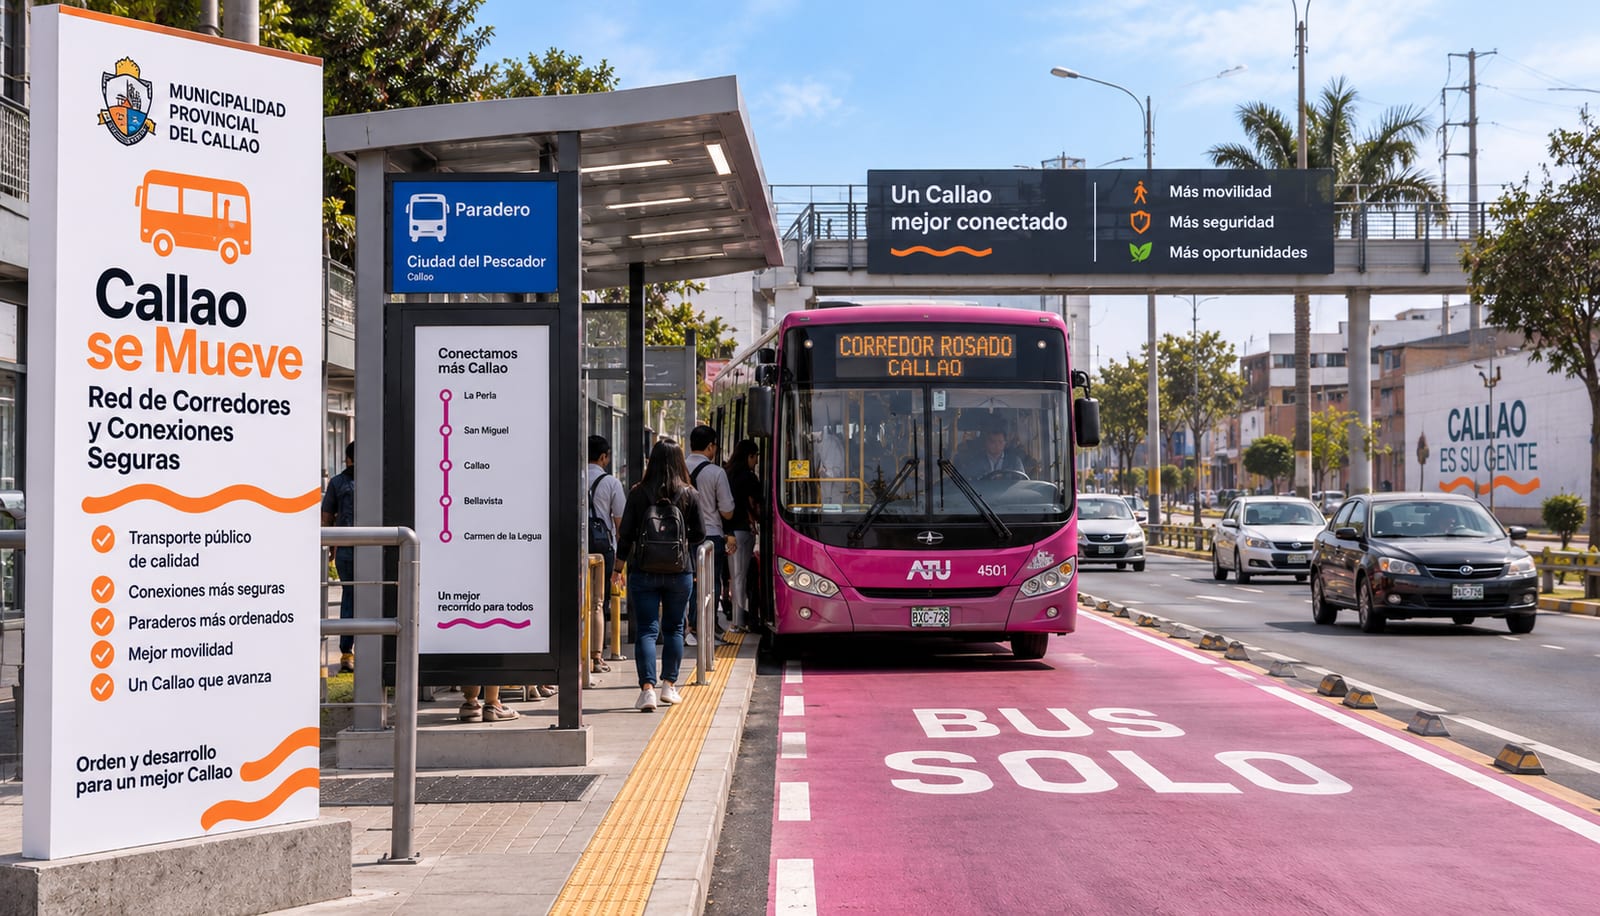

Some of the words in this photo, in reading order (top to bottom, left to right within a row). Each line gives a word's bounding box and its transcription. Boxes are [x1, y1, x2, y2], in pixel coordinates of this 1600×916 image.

[169, 83, 286, 117] MUNICIPALIDAD
[169, 104, 259, 134] PROVINCIAL
[170, 125, 197, 144] DEL
[202, 131, 260, 154] CALLAO
[892, 185, 919, 203] Un
[926, 185, 991, 203] Callao
[1170, 185, 1198, 197] Más
[1203, 185, 1271, 197] movilidad
[456, 202, 530, 216] Paradero
[892, 212, 951, 234] mejor
[957, 212, 1067, 230] conectado
[1170, 216, 1199, 228] Más
[1203, 216, 1273, 231] seguridad
[408, 255, 455, 267] Ciudad
[459, 255, 479, 267] del
[484, 255, 546, 267] Pescador
[1170, 246, 1199, 258] Más
[1203, 246, 1307, 261] oportunidades
[407, 272, 434, 281] Callao
[96, 268, 246, 327] Callao
[87, 332, 143, 371] se
[156, 326, 303, 380] Mueve
[439, 348, 517, 359] Conectamos
[840, 336, 934, 356] CORREDOR
[941, 336, 1012, 356] ROSADO
[439, 362, 465, 373] más
[469, 362, 508, 373] Callao
[889, 359, 961, 376] CALLAO
[89, 386, 132, 409] Red
[139, 388, 166, 410] de
[173, 390, 290, 415] Corredores
[88, 422, 101, 443] y
[108, 417, 233, 441] Conexiones
[1448, 400, 1526, 442] CALLAO
[464, 426, 479, 434] San
[482, 426, 509, 436] Miguel
[88, 446, 180, 475] Seguras
[1440, 447, 1456, 472] ES
[1461, 446, 1479, 472] SU
[1484, 443, 1537, 471] GENTE
[129, 531, 201, 547] Transporte
[205, 530, 251, 547] público
[464, 532, 495, 540] Carmen
[497, 532, 507, 540] de
[509, 532, 516, 540] la
[518, 533, 541, 542] Legua
[129, 554, 146, 568] de
[151, 553, 199, 567] calidad
[907, 560, 951, 580] ATU
[978, 565, 1006, 576] 4501
[129, 584, 205, 598] Conexiones
[209, 582, 234, 596] más
[238, 584, 285, 598] seguras
[438, 592, 451, 600] Un
[453, 591, 480, 603] mejor
[438, 602, 481, 611] recorrido
[483, 604, 504, 613] para
[506, 602, 533, 611] todos
[129, 615, 196, 629] Paraderos
[200, 613, 225, 626] más
[229, 610, 294, 625] ordenados
[129, 646, 167, 663] Mejor
[171, 642, 233, 658] movilidad
[129, 678, 147, 692] Un
[152, 675, 194, 690] Callao
[199, 676, 223, 691] que
[227, 671, 272, 686] avanza
[913, 708, 1185, 738] BUS
[77, 754, 125, 772] Orden
[130, 755, 139, 771] y
[143, 745, 216, 767] desarrollo
[77, 779, 112, 798] para
[117, 777, 135, 789] un
[141, 772, 184, 789] mejor
[188, 765, 232, 782] Callao
[885, 750, 1353, 795] SOLO
